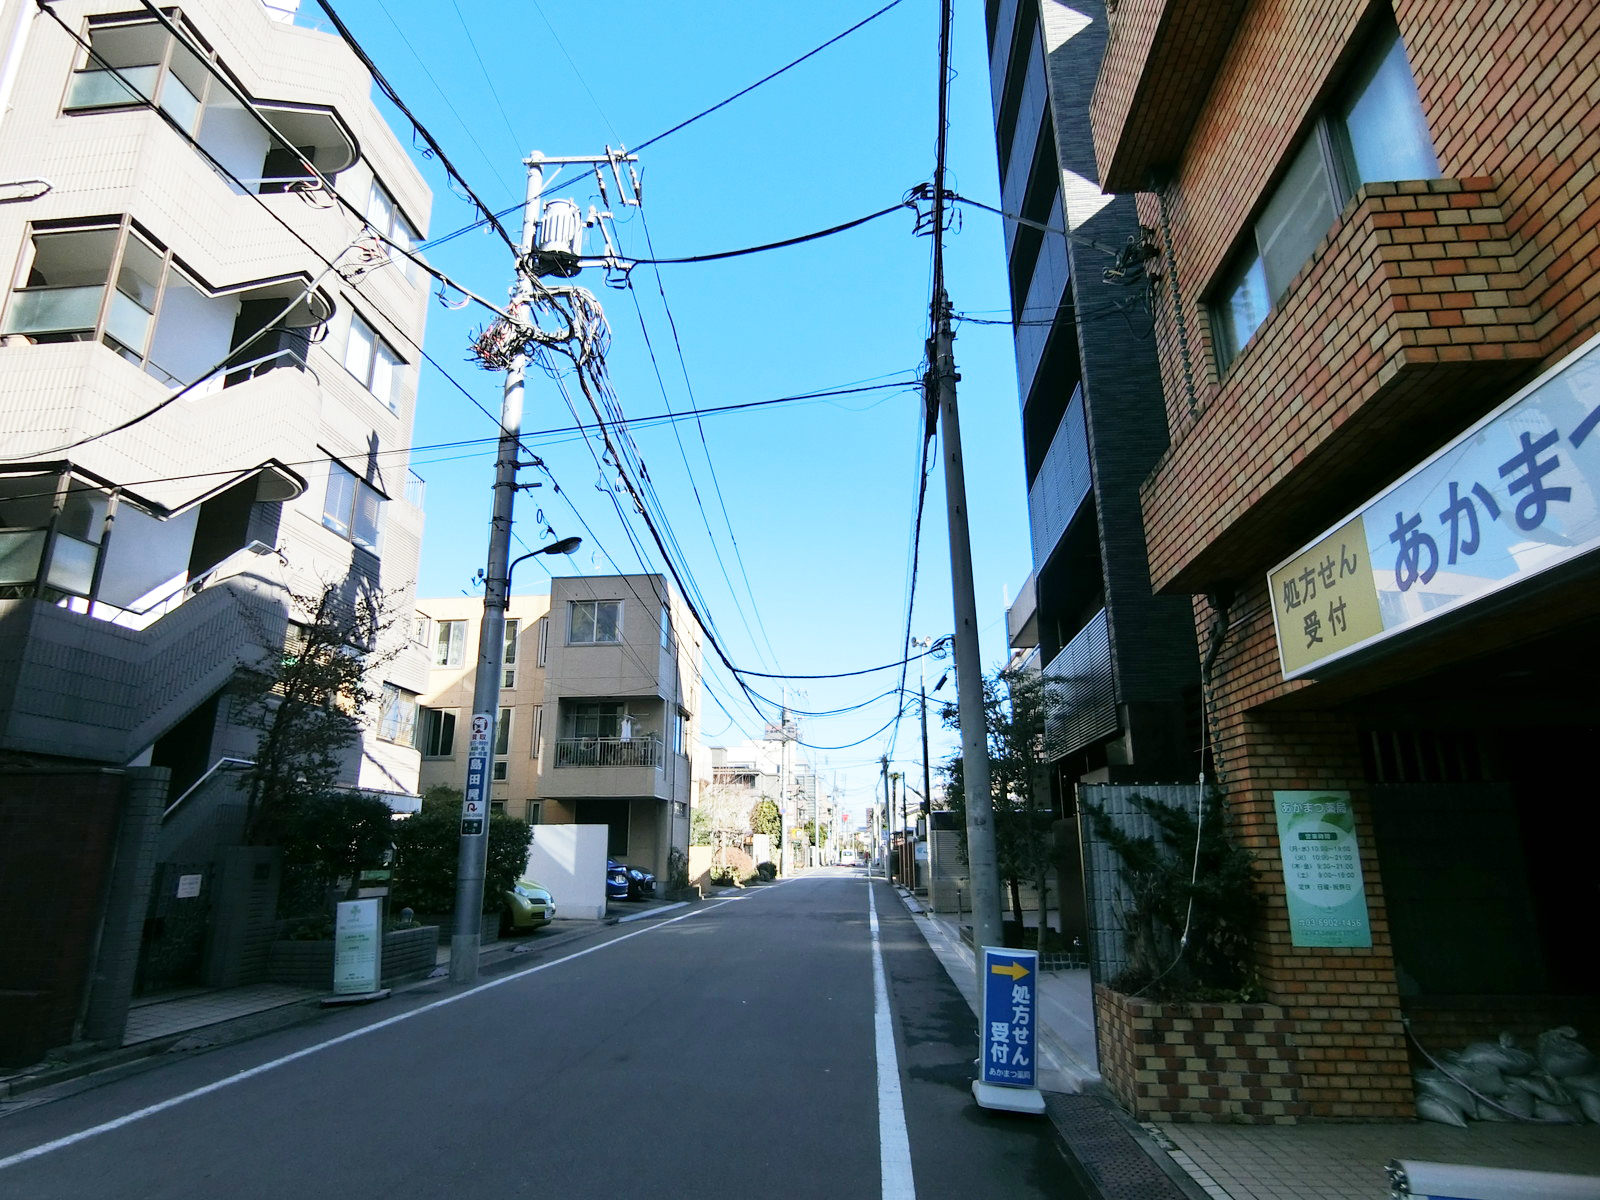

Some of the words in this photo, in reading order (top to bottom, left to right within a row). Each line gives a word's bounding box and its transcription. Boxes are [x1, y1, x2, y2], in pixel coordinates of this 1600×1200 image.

[1282, 543, 1357, 614] 処方せん
[1302, 595, 1348, 650] 受付
[1281, 802, 1347, 814] あかまつ薬局
[991, 1022, 1010, 1065] 受付
[1012, 984, 1031, 1066] 処方せん
